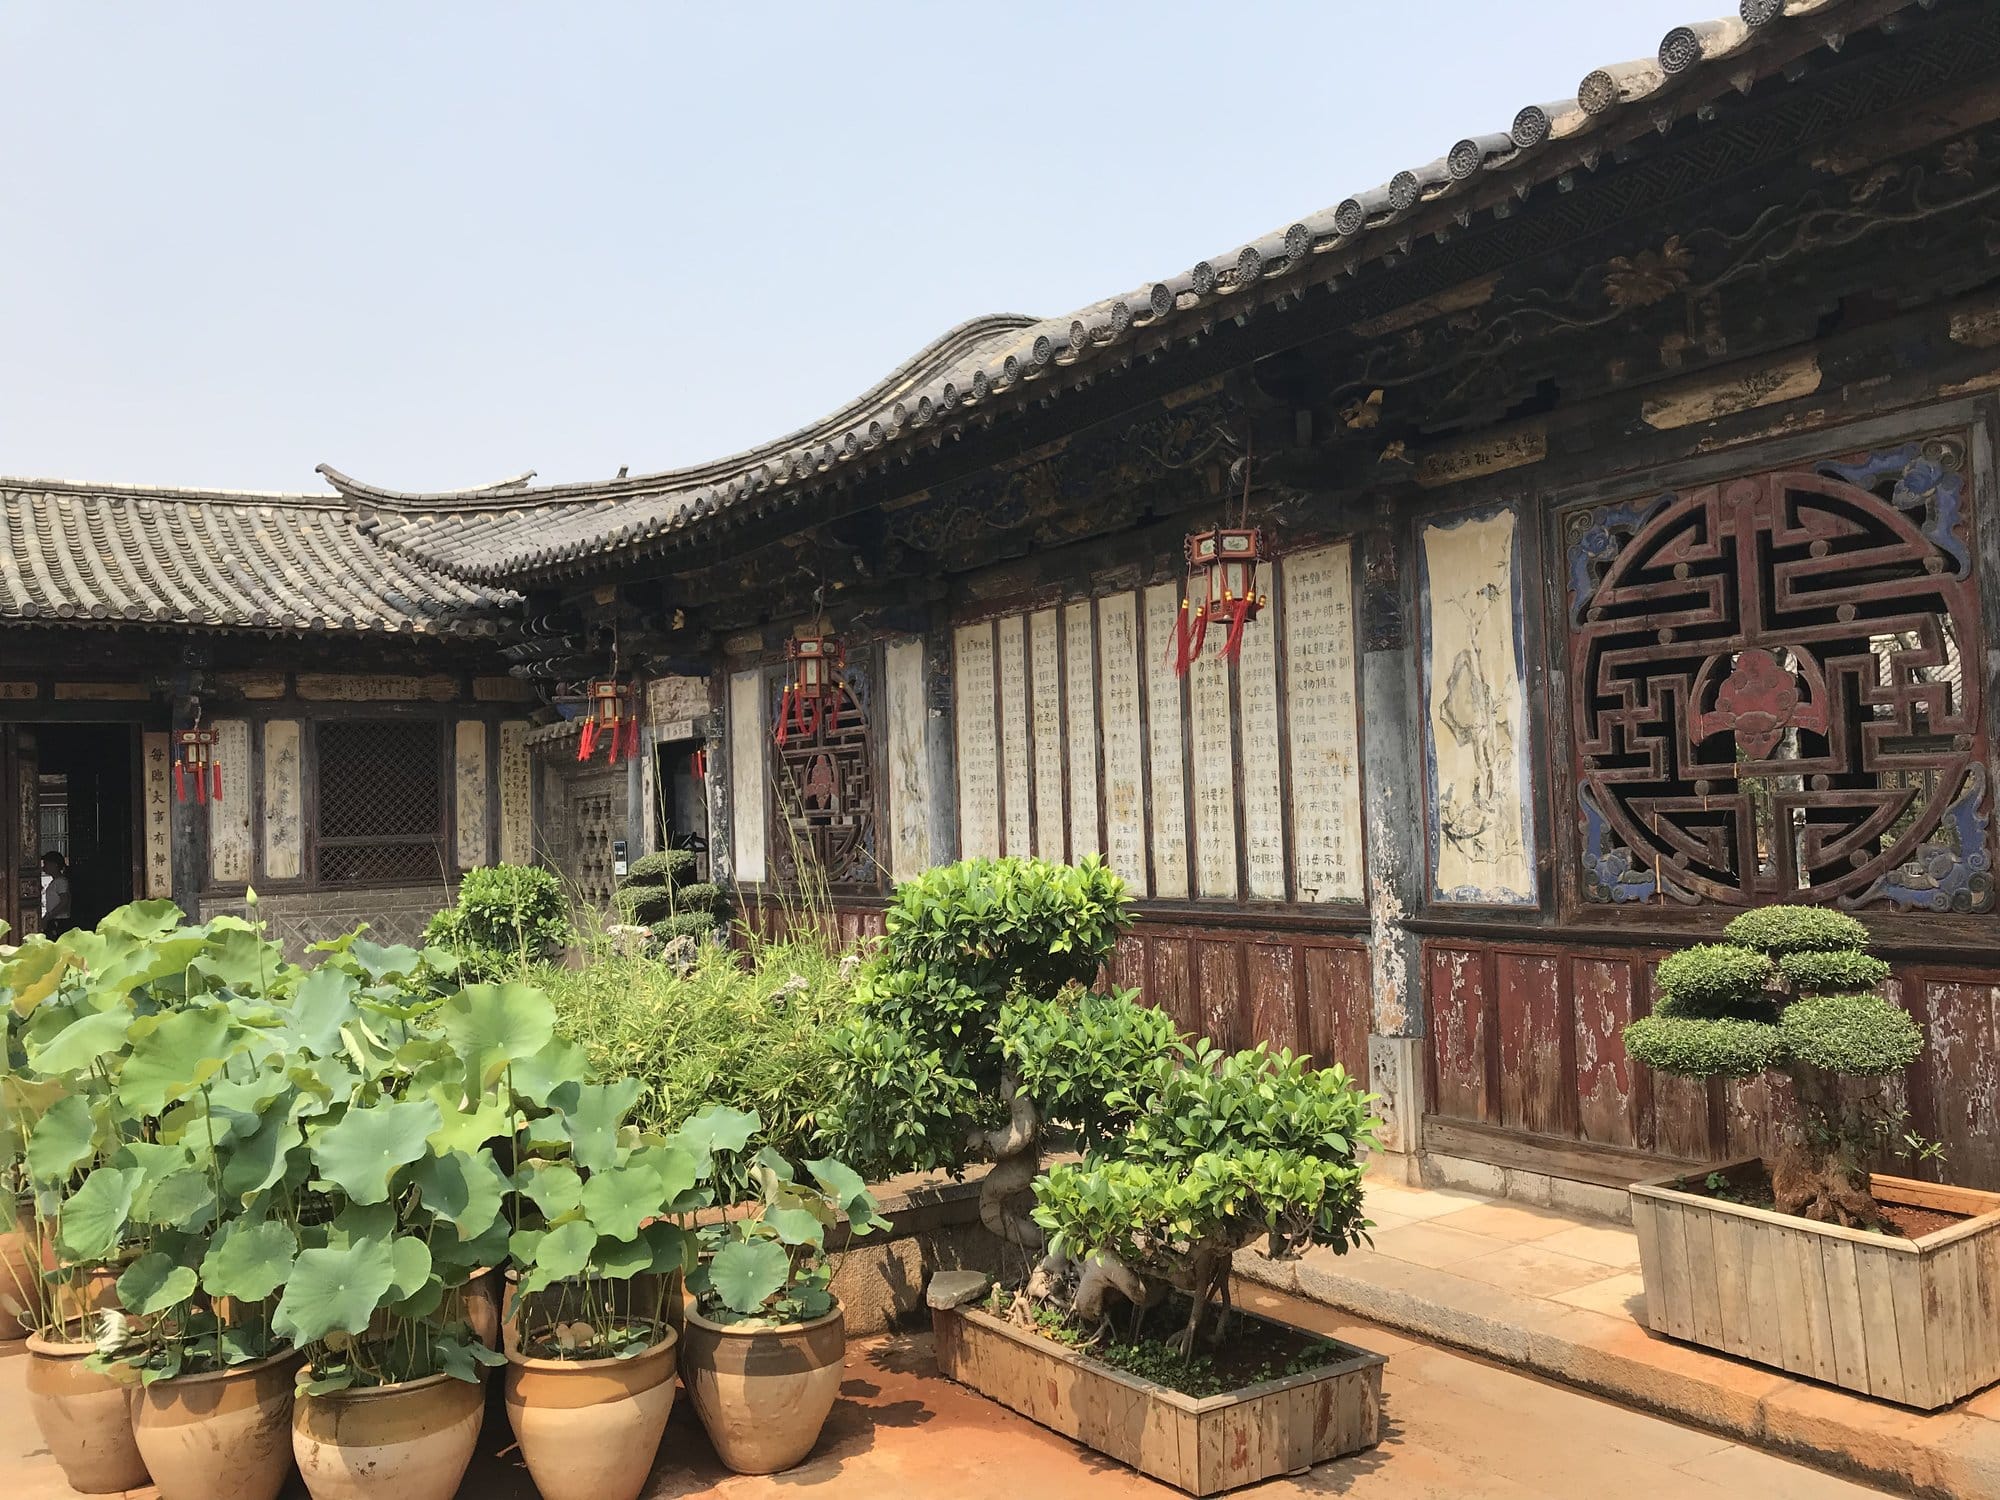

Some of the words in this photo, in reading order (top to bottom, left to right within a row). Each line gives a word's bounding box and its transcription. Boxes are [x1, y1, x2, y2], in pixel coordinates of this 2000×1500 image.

[149, 747, 167, 887] 每臨大事有靜氣
